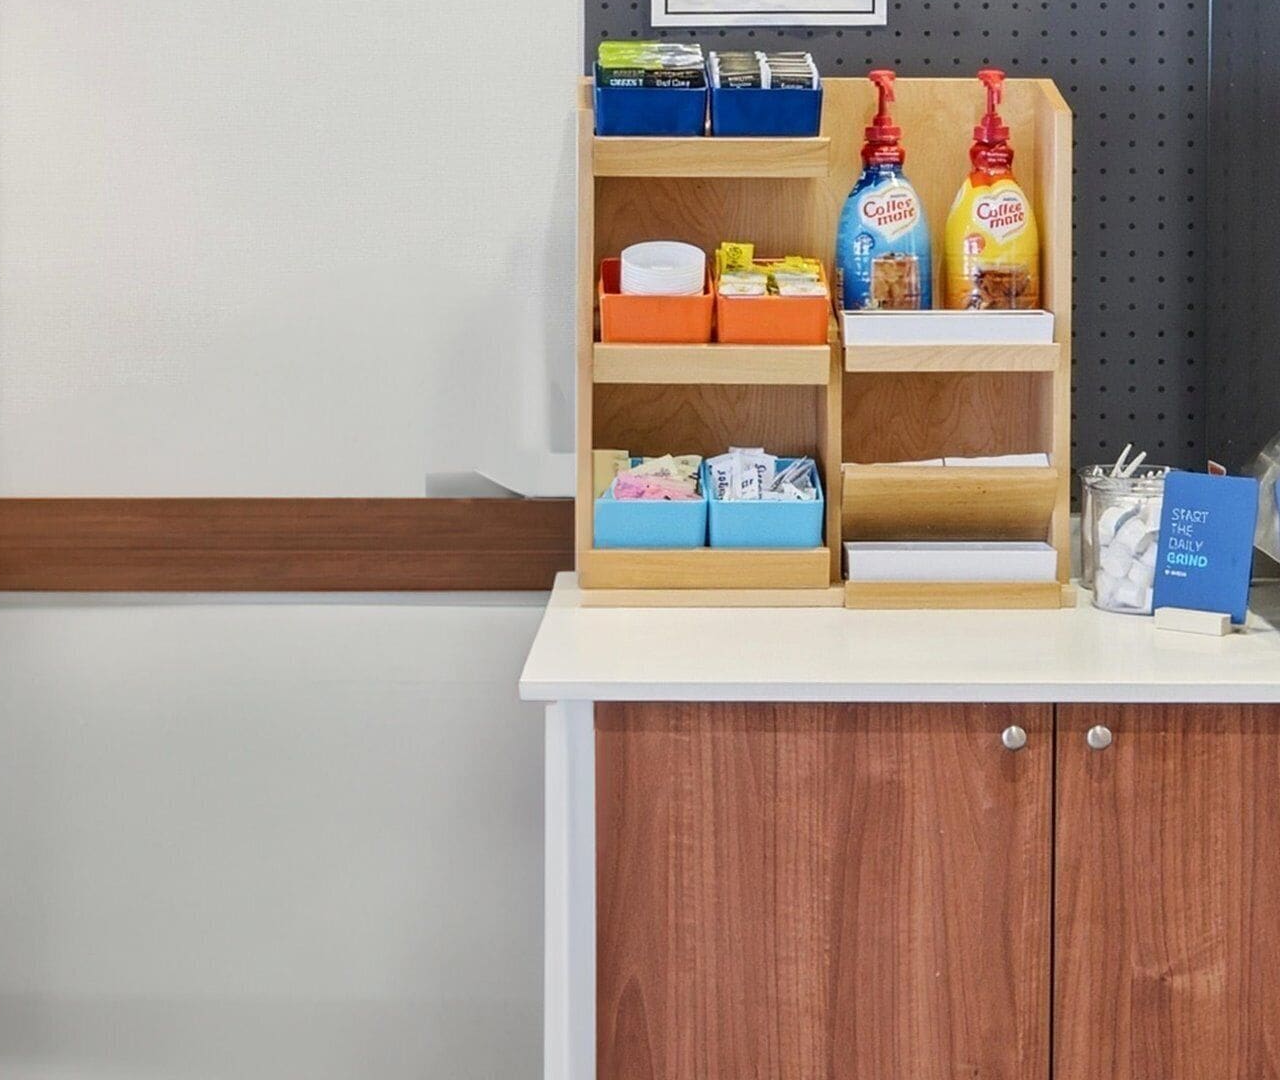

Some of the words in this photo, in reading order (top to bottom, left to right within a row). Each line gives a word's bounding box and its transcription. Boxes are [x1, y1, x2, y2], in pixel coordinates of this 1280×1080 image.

[976, 202, 1023, 220] Coffee
[989, 211, 1025, 229] mate
[1171, 507, 1209, 523] START
[1171, 523, 1194, 537] THE
[1168, 537, 1204, 552] DAILY
[1166, 551, 1208, 568] GRIND
